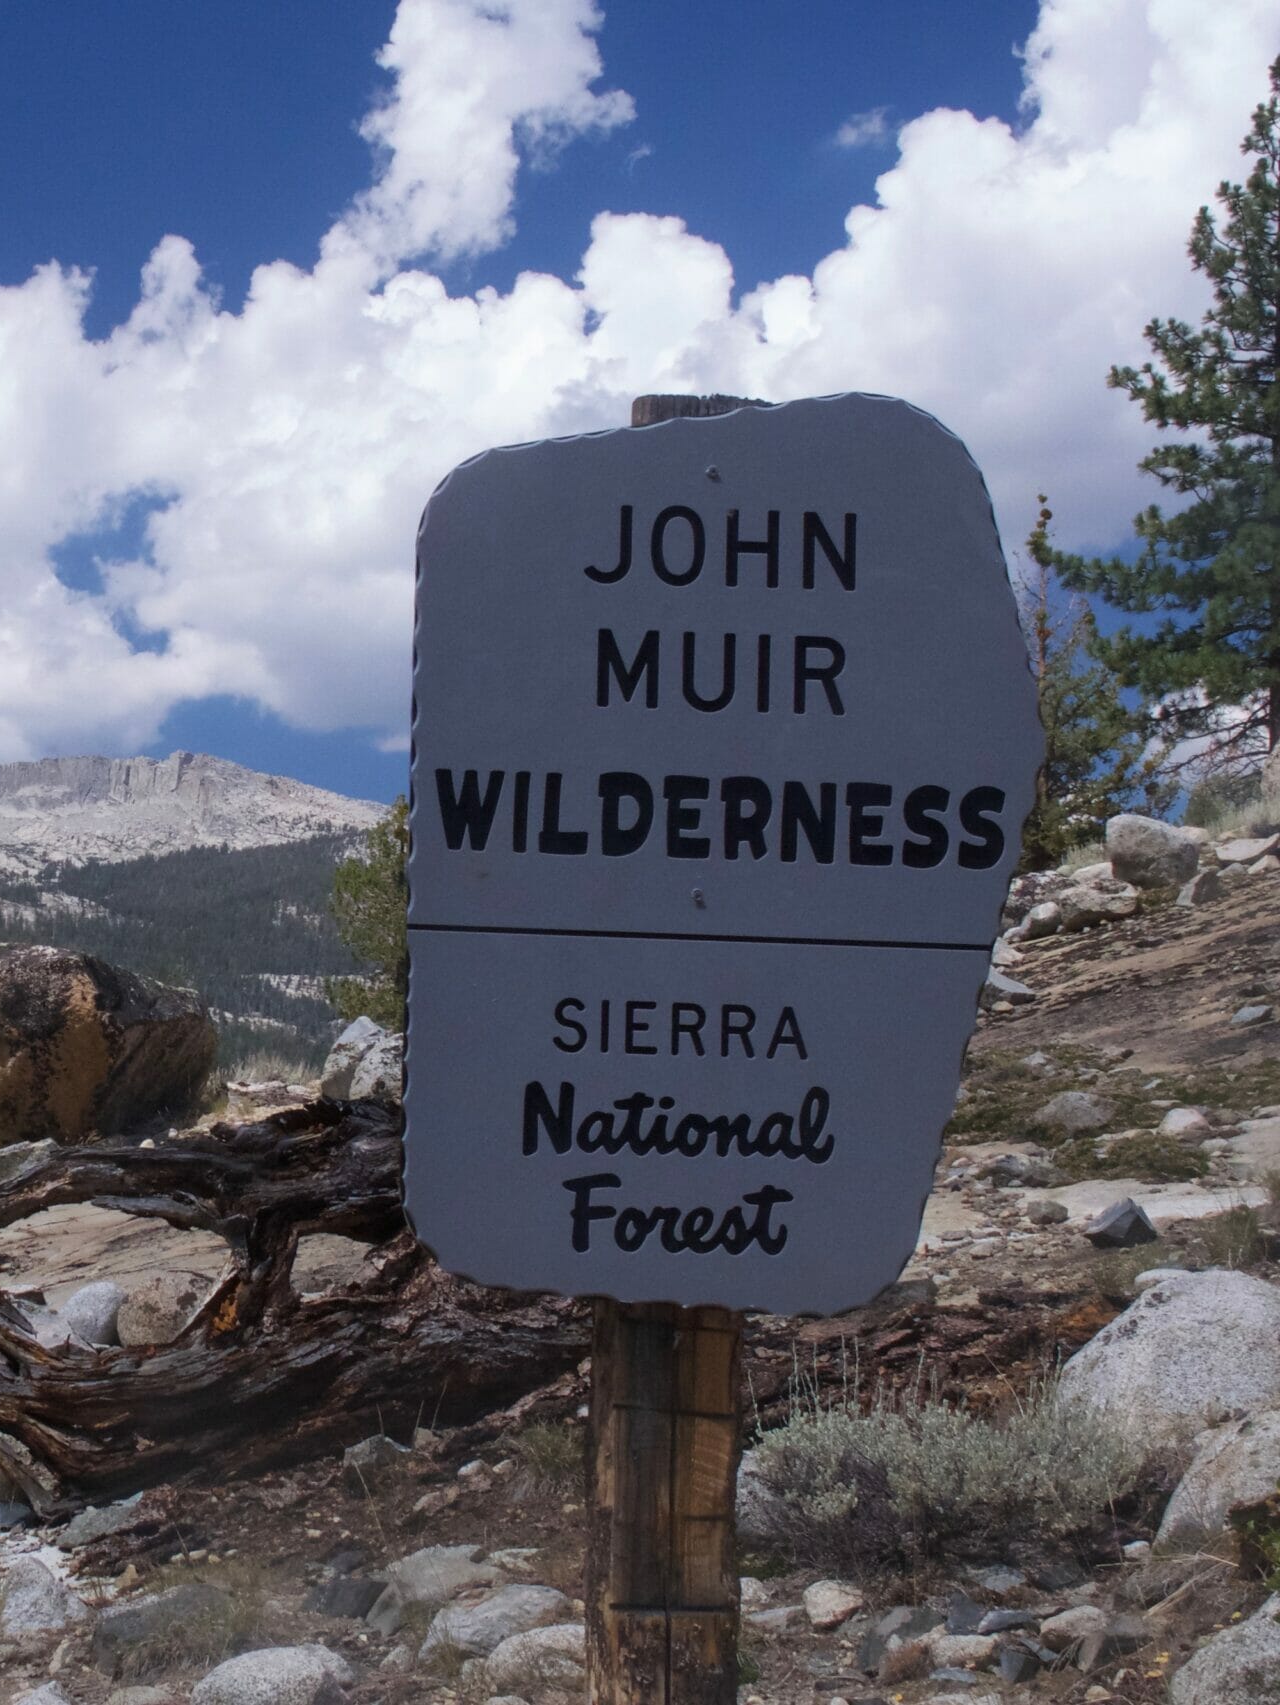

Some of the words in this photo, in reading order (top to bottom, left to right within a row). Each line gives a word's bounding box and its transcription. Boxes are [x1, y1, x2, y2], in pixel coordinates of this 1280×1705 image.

[583, 504, 857, 591] JOHN
[596, 628, 846, 716] MUIR
[435, 768, 1006, 869] WILDERNESS
[553, 998, 808, 1060] SIERRA
[522, 1080, 835, 1164] National
[562, 1173, 793, 1256] Forest
